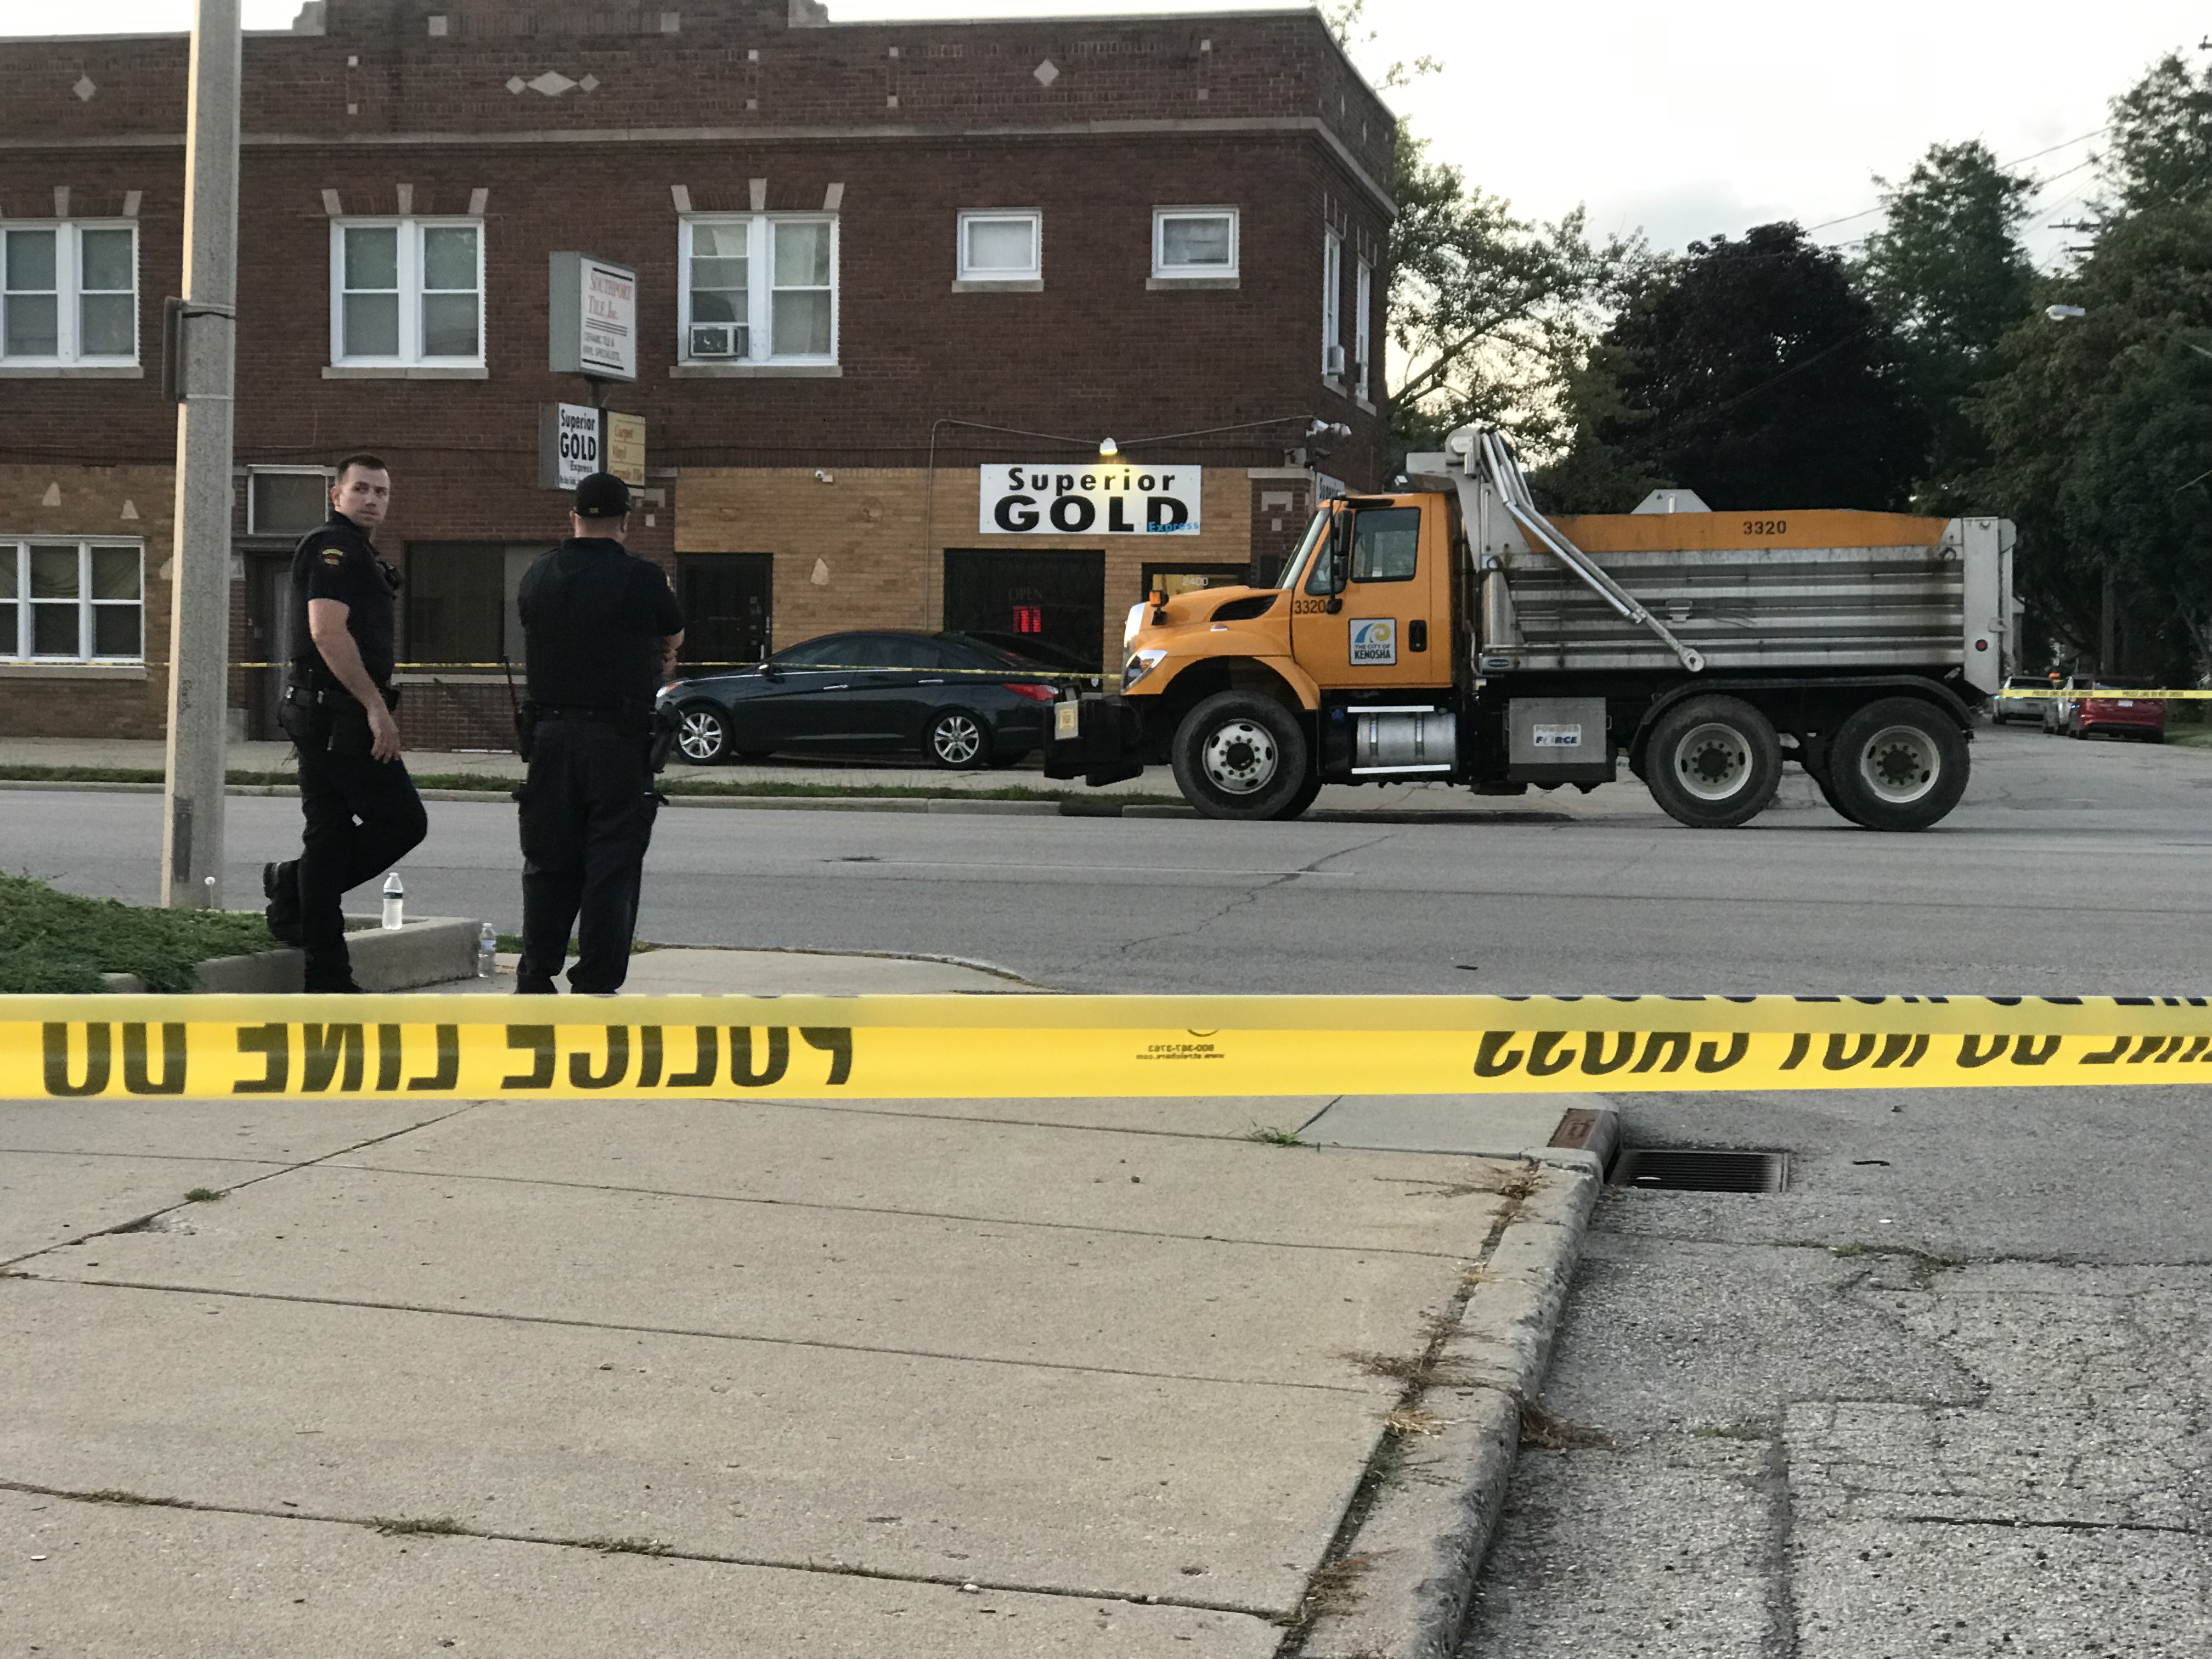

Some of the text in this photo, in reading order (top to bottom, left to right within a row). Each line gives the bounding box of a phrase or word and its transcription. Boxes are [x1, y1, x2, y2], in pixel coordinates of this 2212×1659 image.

[561, 409, 595, 432] Superior
[614, 424, 633, 441] Carpet
[560, 432, 596, 461] GOLD
[570, 460, 593, 473] Express
[1008, 467, 1176, 496] Superior
[994, 495, 1189, 532] GOLD
[1148, 521, 1200, 533] Express
[1743, 520, 1787, 535] 3320
[1182, 577, 1209, 586] 2400
[1294, 600, 1325, 614] 3320
[1355, 649, 1391, 659] KENOSHA
